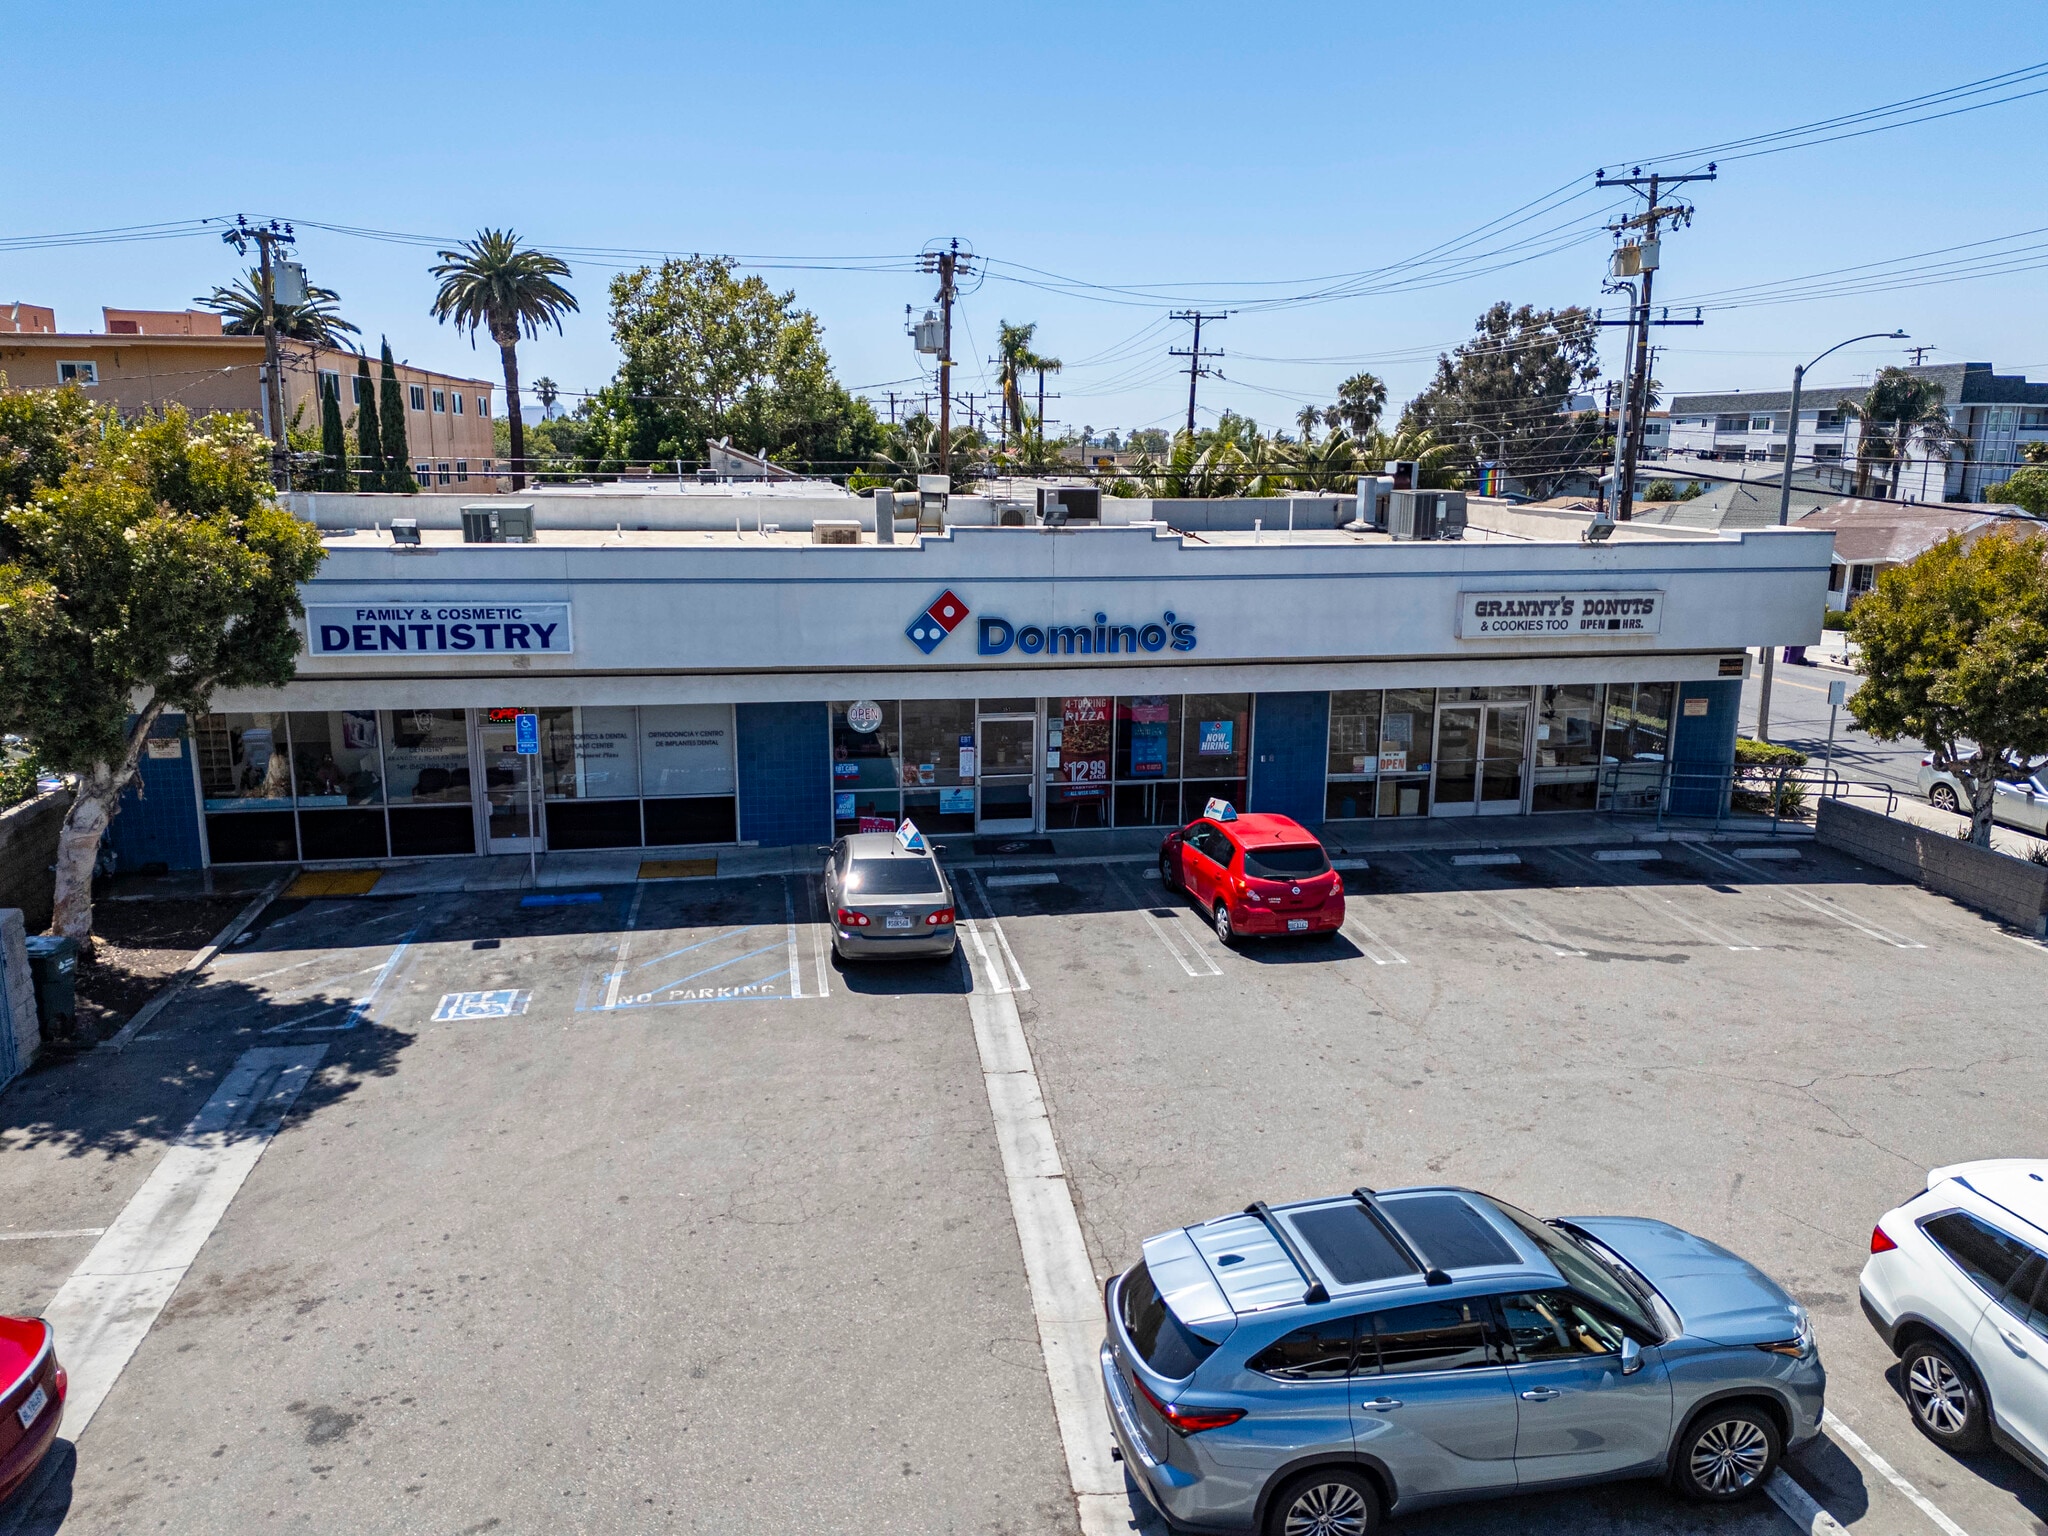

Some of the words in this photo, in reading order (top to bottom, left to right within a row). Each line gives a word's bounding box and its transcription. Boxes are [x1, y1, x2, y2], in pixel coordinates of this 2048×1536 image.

[1474, 595, 1575, 618] GRANNY'S
[1582, 598, 1655, 616] DONUTS
[356, 608, 415, 621] FAMILY
[420, 608, 432, 620] &
[437, 608, 523, 620] COSMETIC
[1480, 621, 1489, 631] &
[1492, 620, 1543, 631] COOKIES
[1546, 619, 1569, 630] TOO
[1580, 619, 1605, 630] OPEN
[1622, 618, 1644, 630] HRS.
[319, 623, 558, 652] DENTISTRY
[977, 610, 1198, 657] Domino's
[850, 708, 879, 721] OPEN
[1206, 733, 1226, 743] NOW
[1201, 741, 1230, 751] HIRING
[1380, 758, 1405, 770] OPEN
[618, 993, 652, 1005] NO
[669, 984, 775, 1001] PARKING
